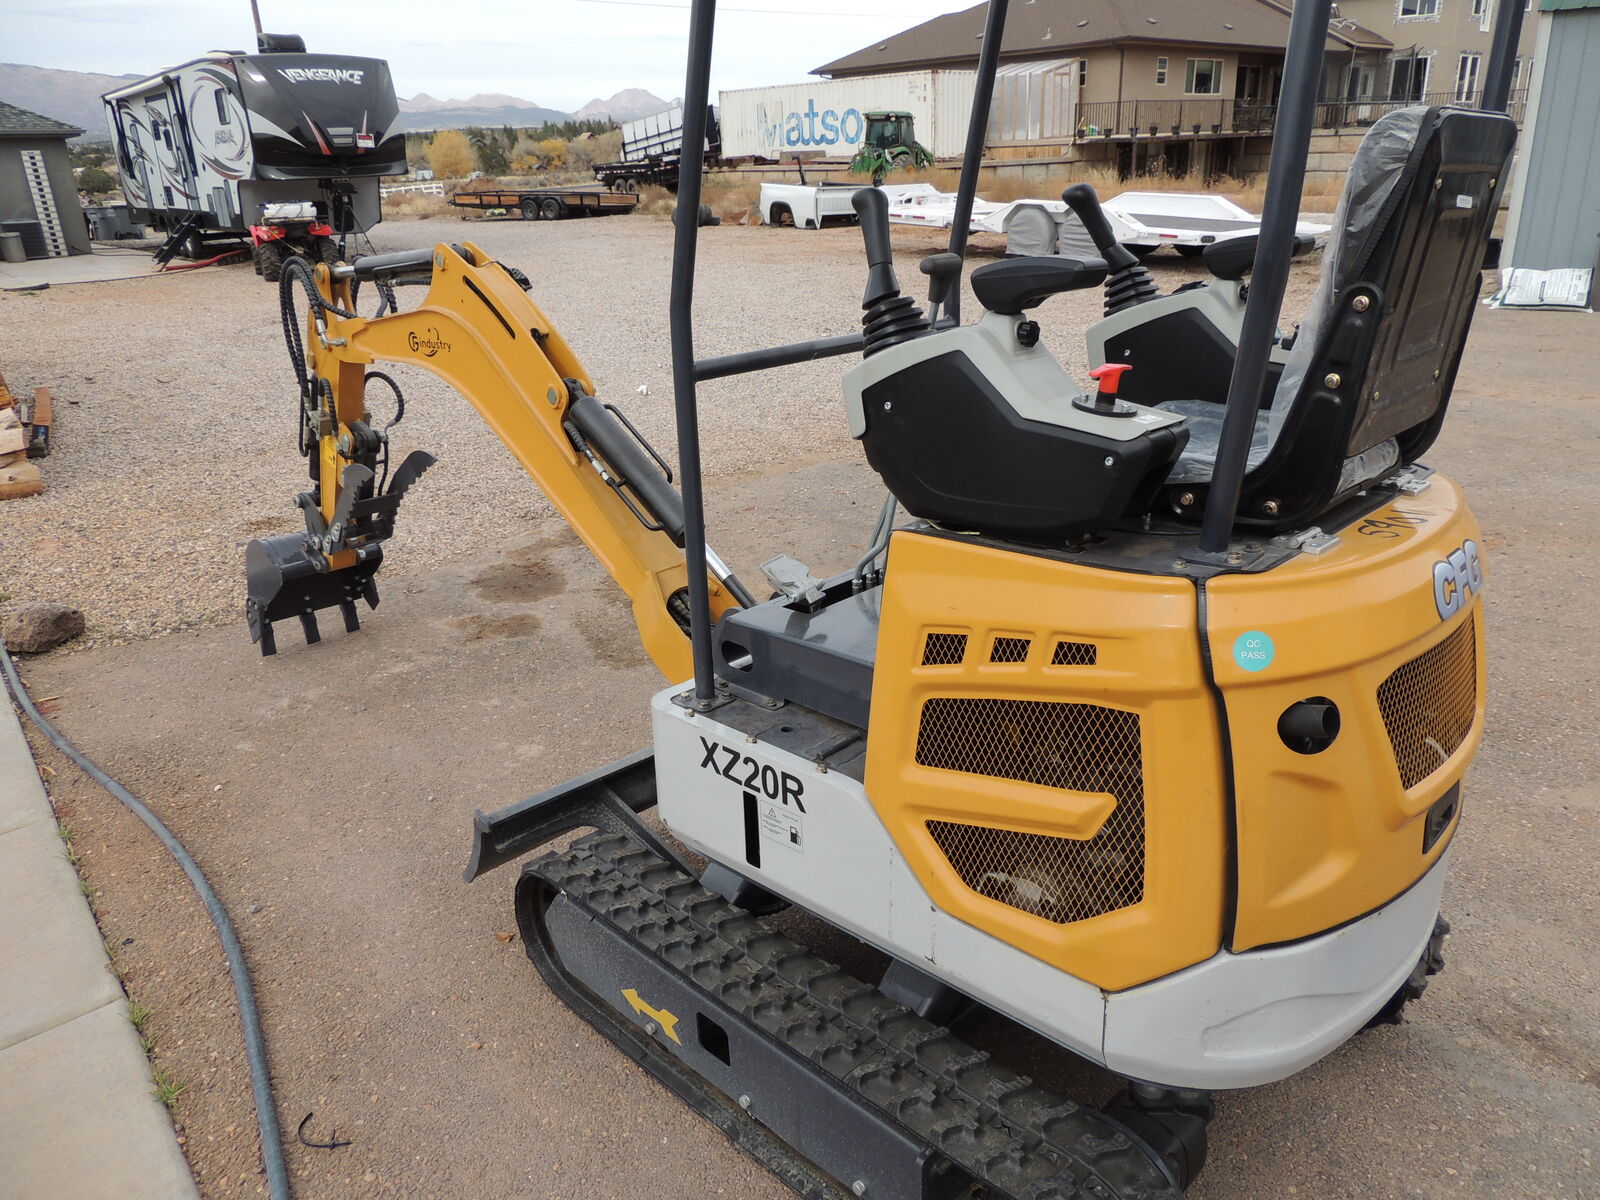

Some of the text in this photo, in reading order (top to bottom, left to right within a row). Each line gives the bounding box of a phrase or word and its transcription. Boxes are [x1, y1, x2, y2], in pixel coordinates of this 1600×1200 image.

[277, 68, 363, 85] VENGEANCE
[757, 98, 863, 147] Matso
[1432, 539, 1482, 622] CFG
[1241, 651, 1266, 660] PASS
[1246, 639, 1261, 648] QC
[700, 735, 806, 814] XZ20R
